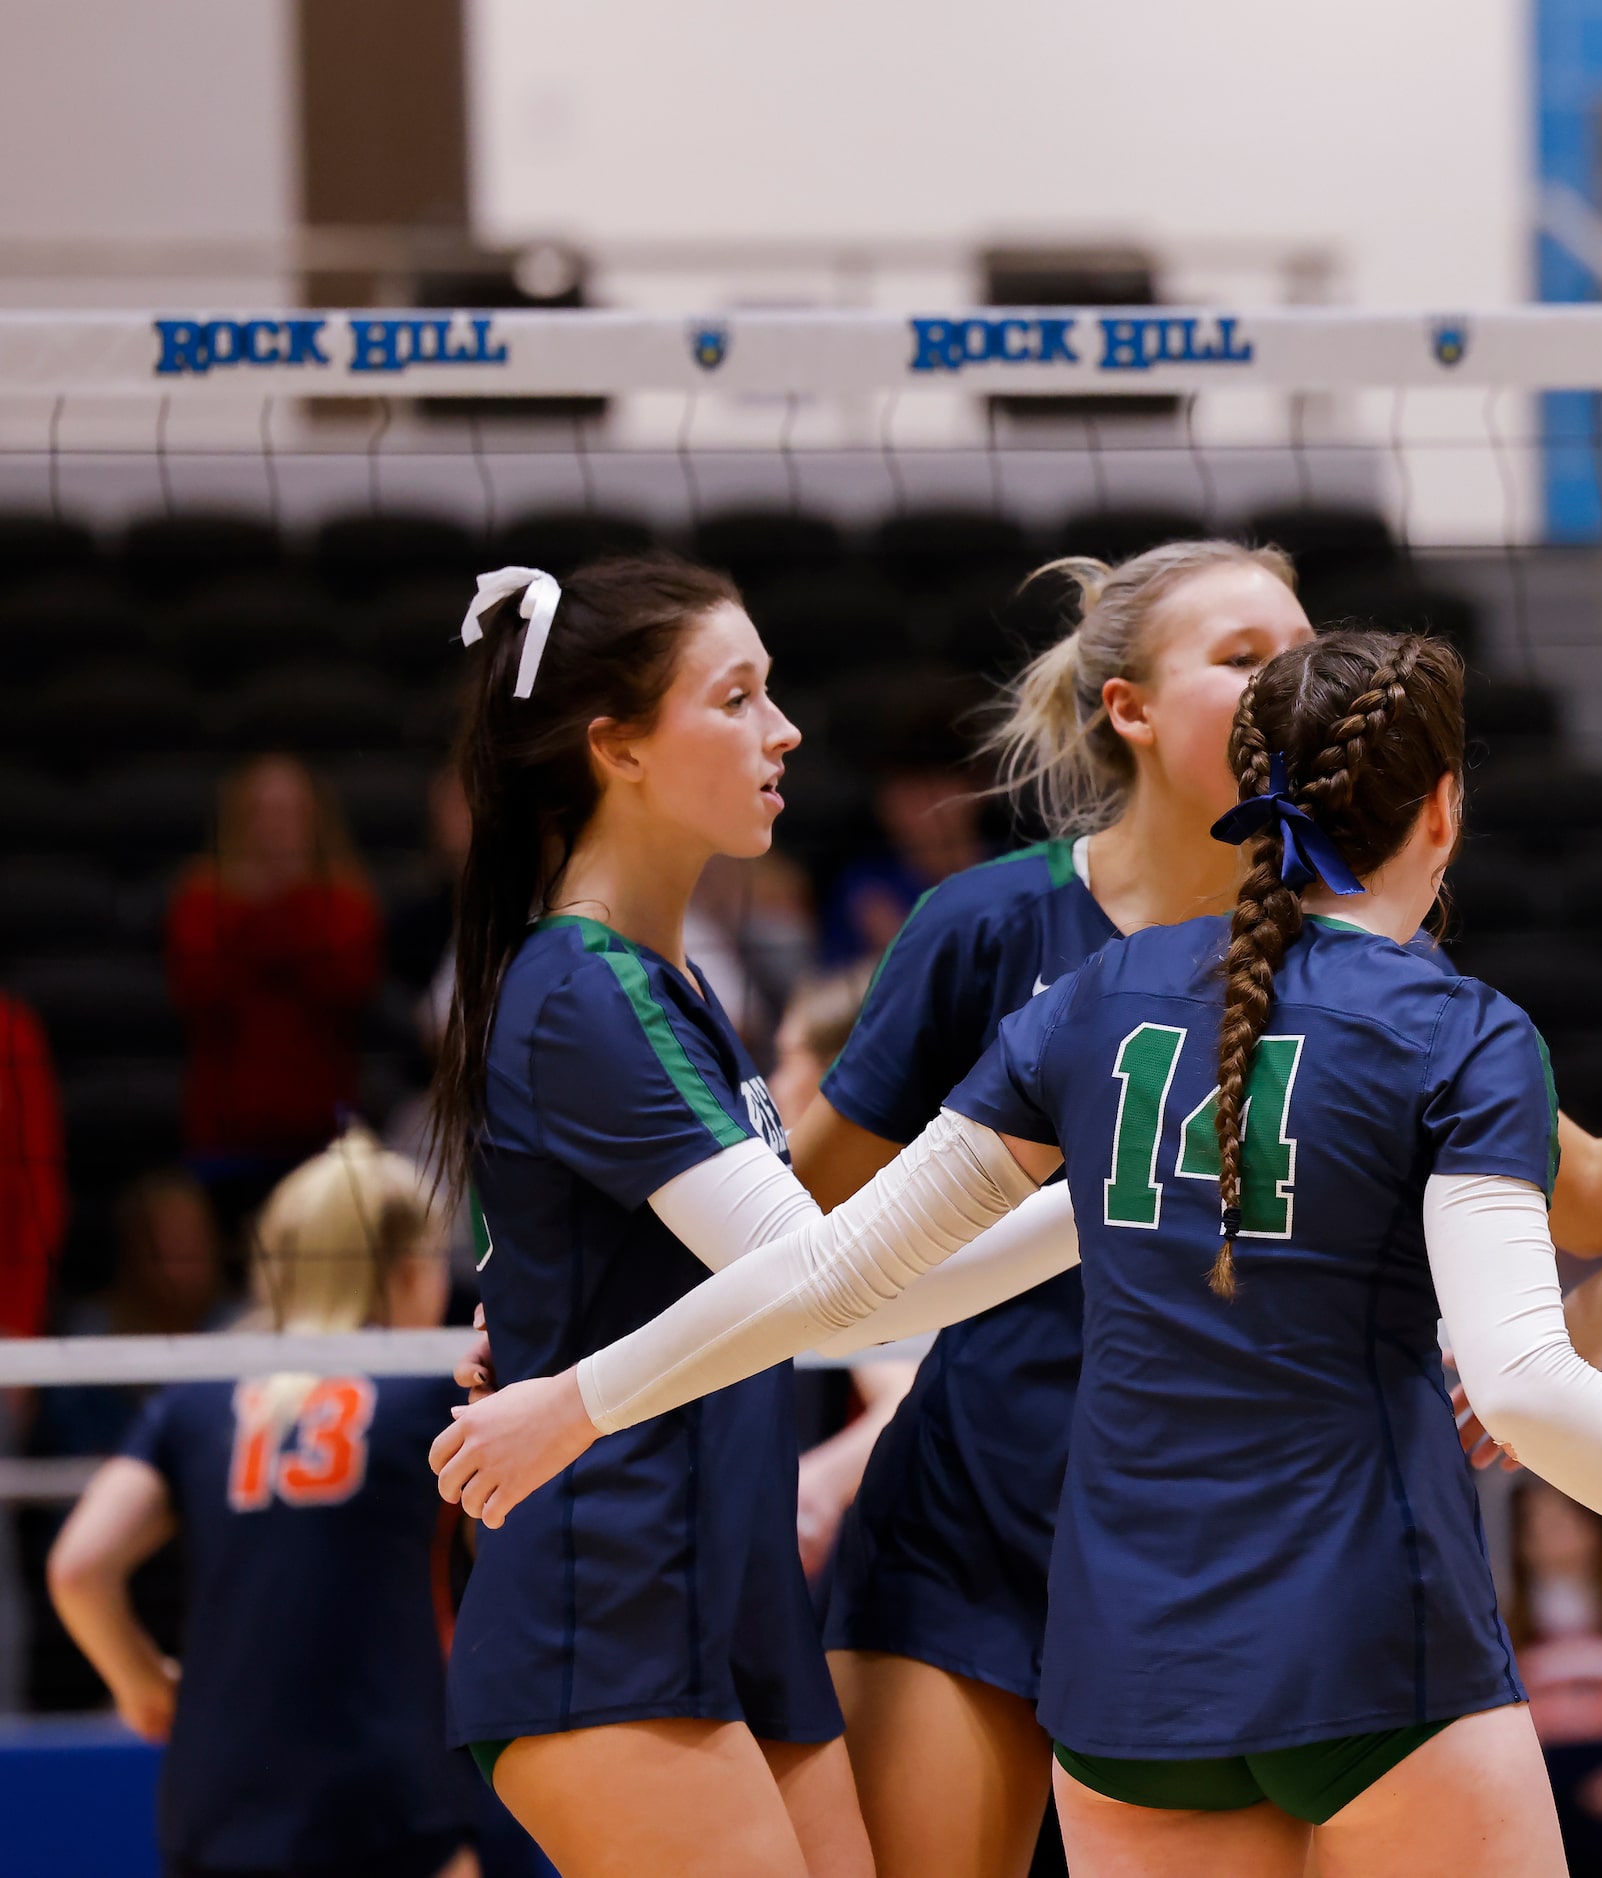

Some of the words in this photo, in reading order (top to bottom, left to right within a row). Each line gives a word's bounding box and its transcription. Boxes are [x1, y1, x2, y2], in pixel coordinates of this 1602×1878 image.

[155, 320, 329, 374] ROCK
[349, 320, 508, 371] HILL
[910, 318, 1079, 371] ROCK
[1097, 318, 1254, 370] HILL
[1103, 1021, 1306, 1240] 14
[228, 1374, 378, 1513] 13
